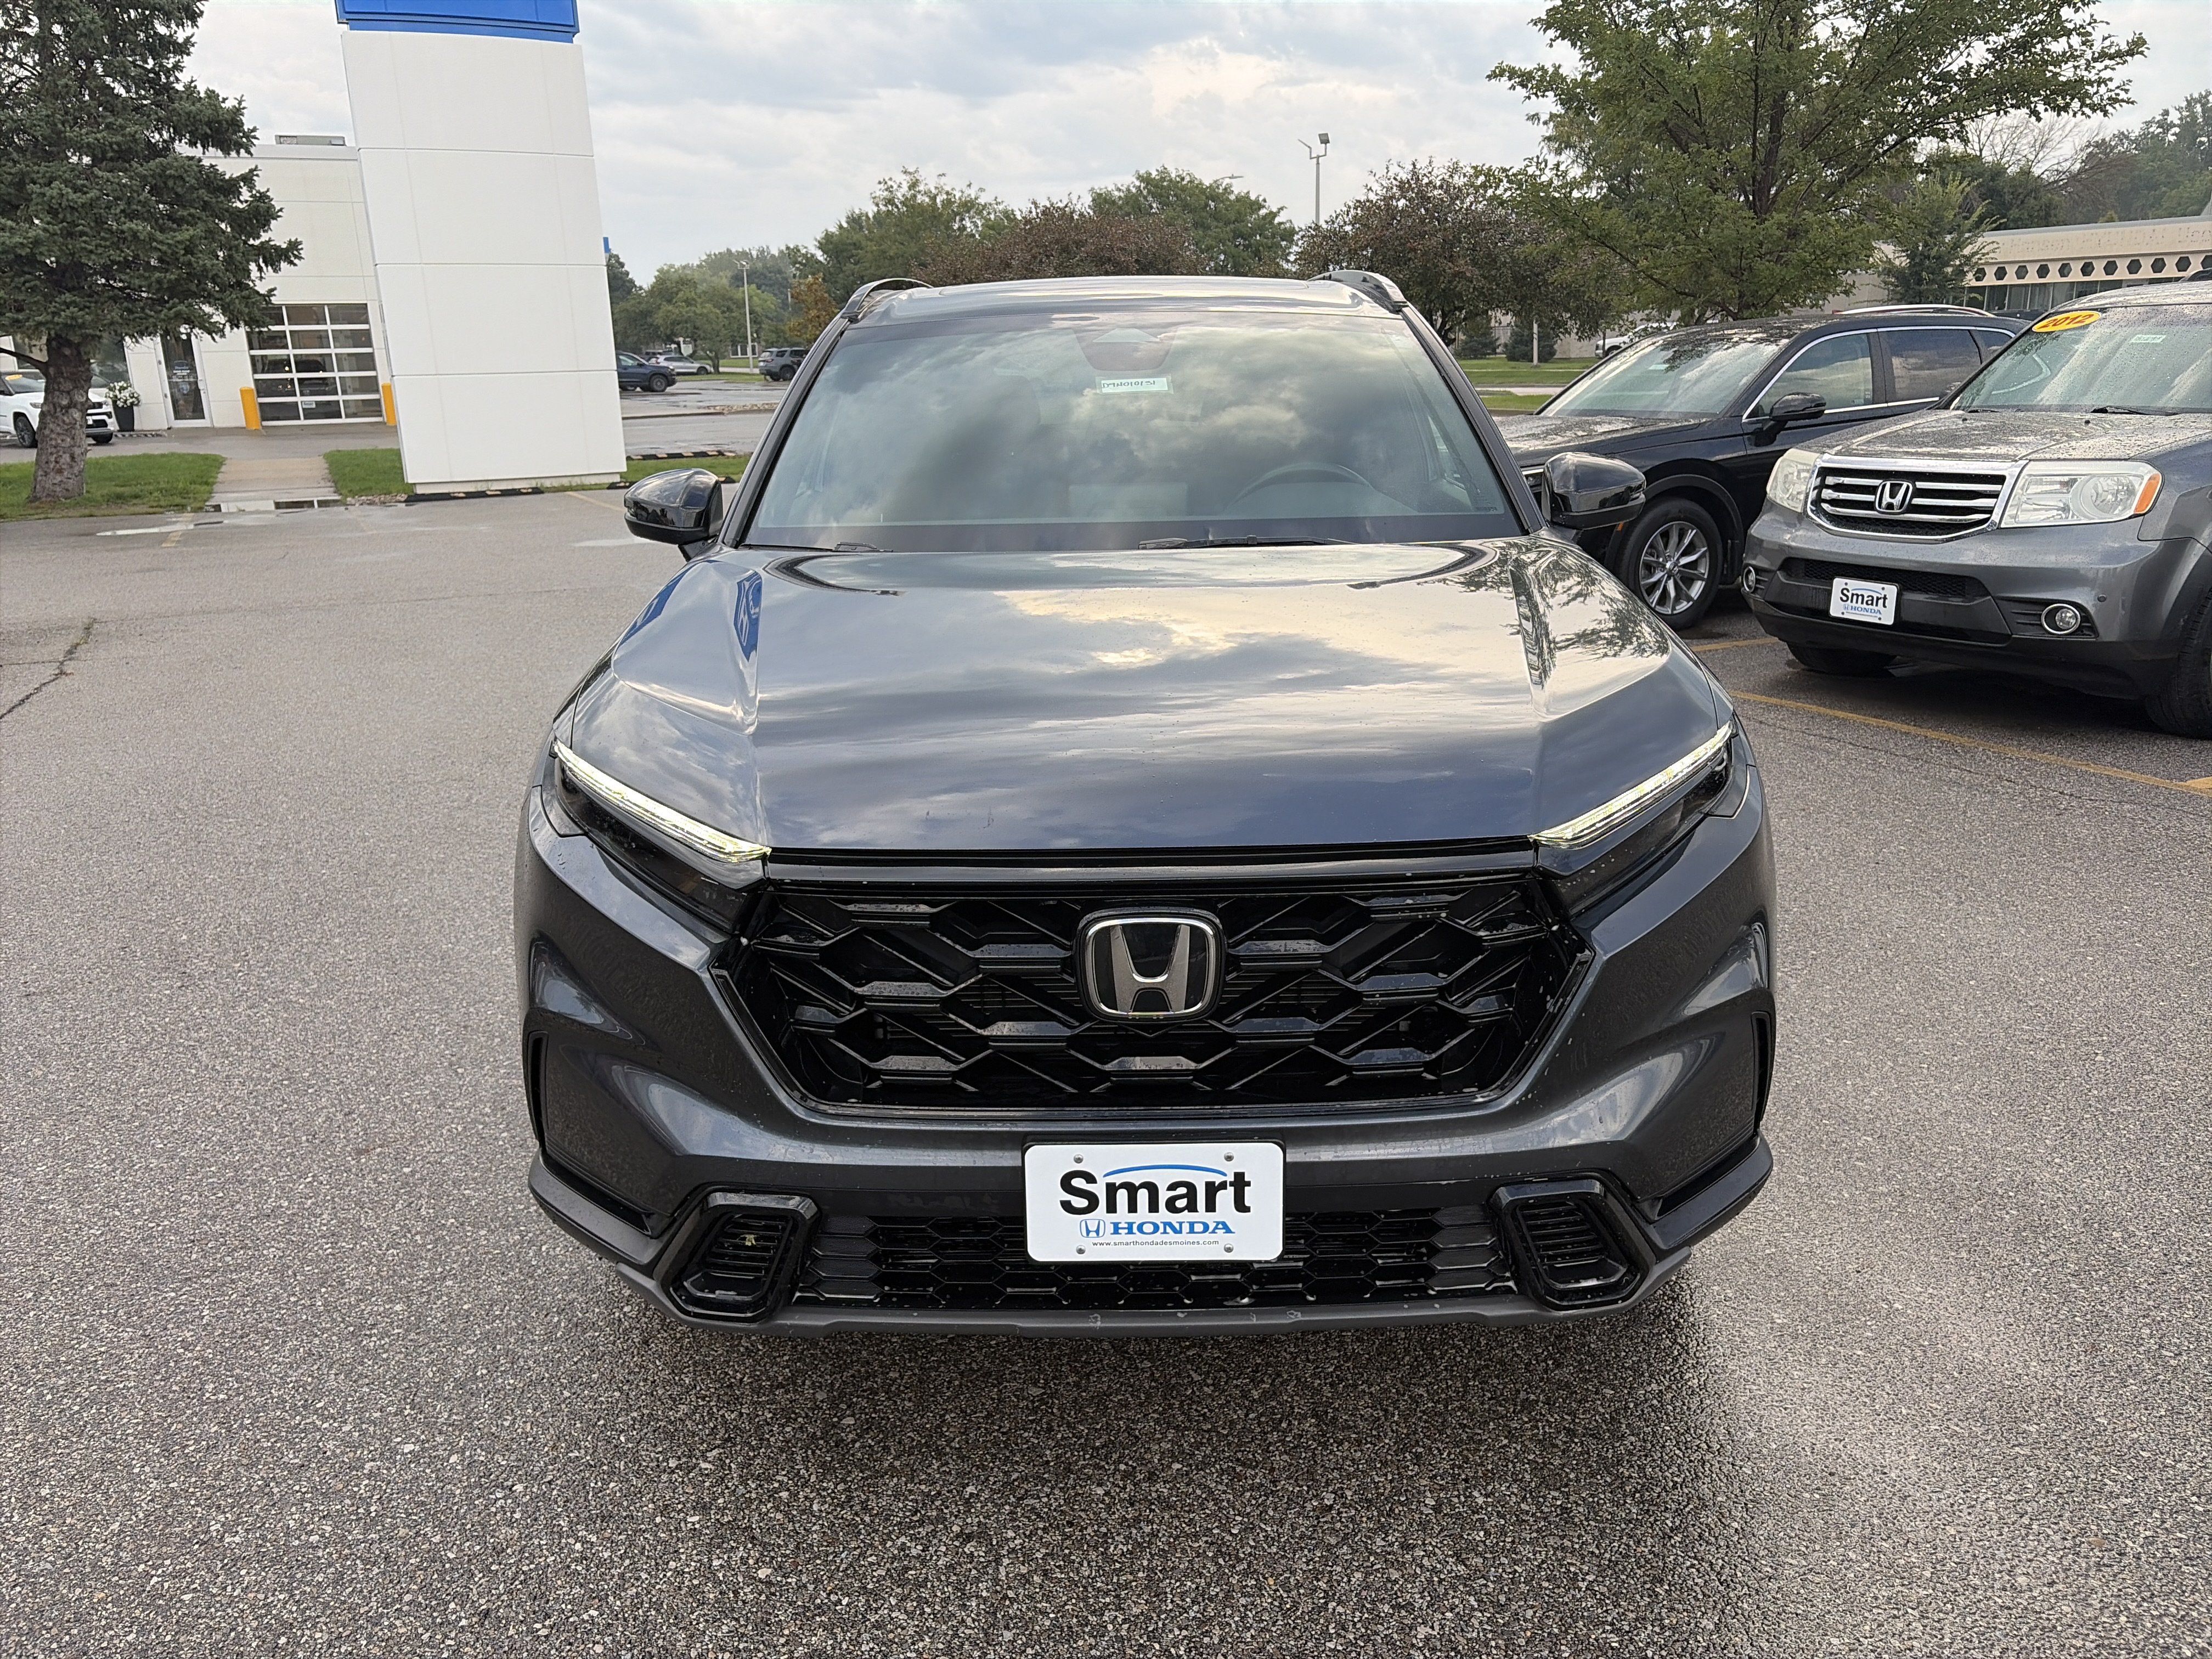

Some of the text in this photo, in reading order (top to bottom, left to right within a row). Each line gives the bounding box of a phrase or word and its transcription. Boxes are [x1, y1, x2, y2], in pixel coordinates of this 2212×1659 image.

[2037, 314, 2095, 329] 2012
[1839, 588, 1888, 608] Smart
[1850, 605, 1882, 615] HONDA
[1059, 1170, 1251, 1215] Smart
[1110, 1221, 1235, 1235] HONDA
